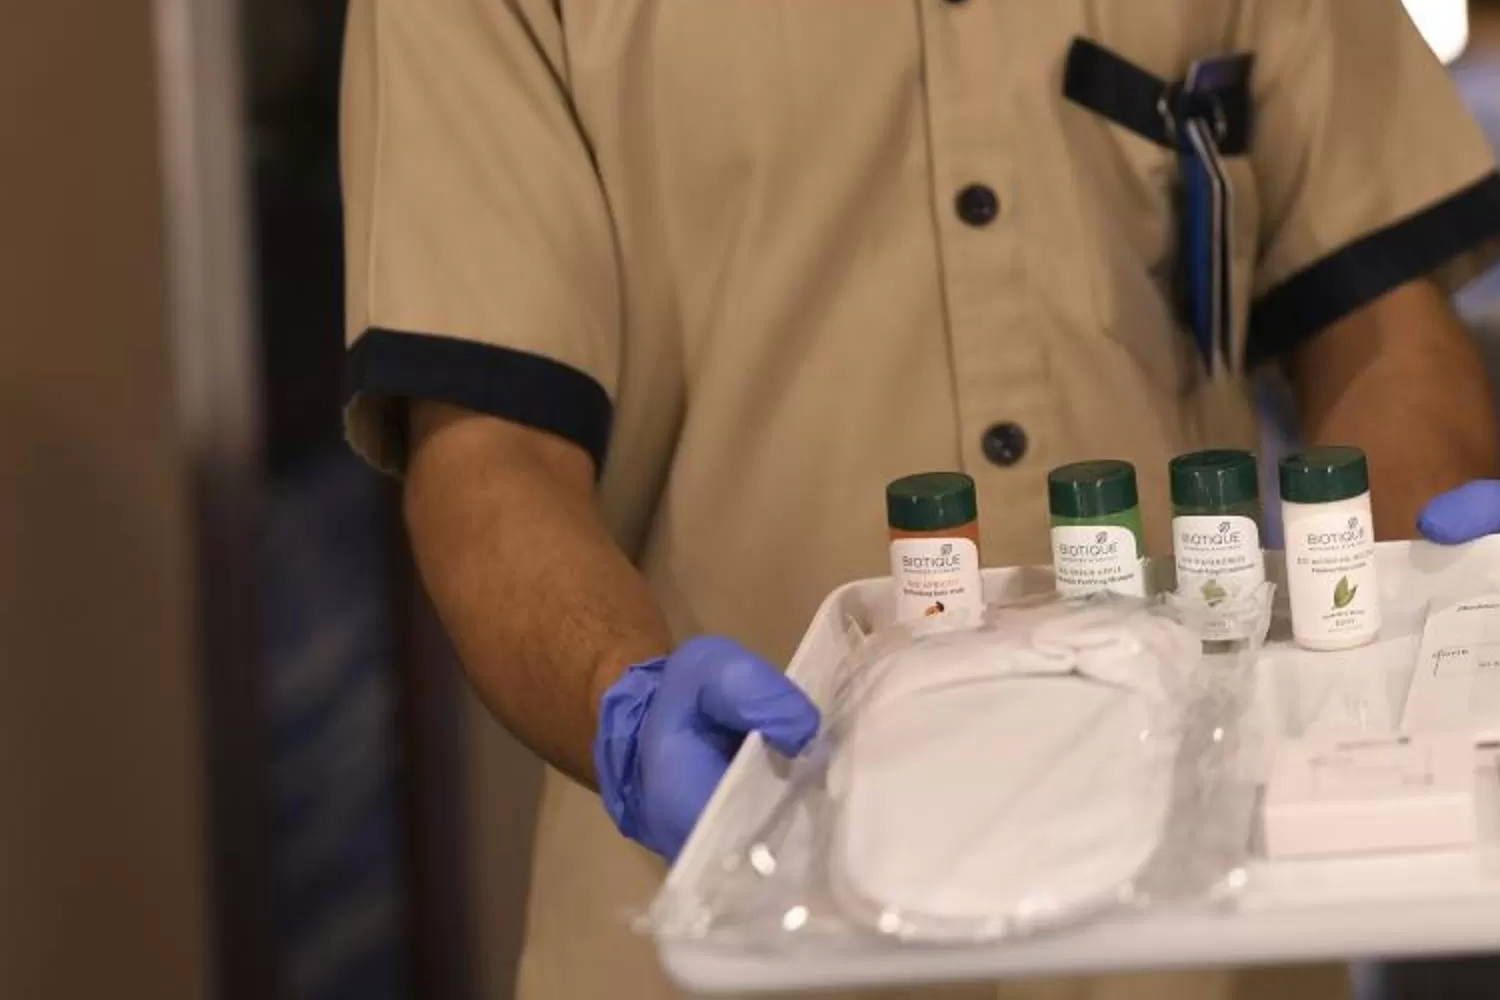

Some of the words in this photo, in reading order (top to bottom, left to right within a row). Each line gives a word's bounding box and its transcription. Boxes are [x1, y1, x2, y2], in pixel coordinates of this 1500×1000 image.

[1181, 531, 1241, 545] BIOTIQUE
[1059, 542, 1119, 557] BIOTIQUE
[902, 554, 961, 569] BIOTIQUE
